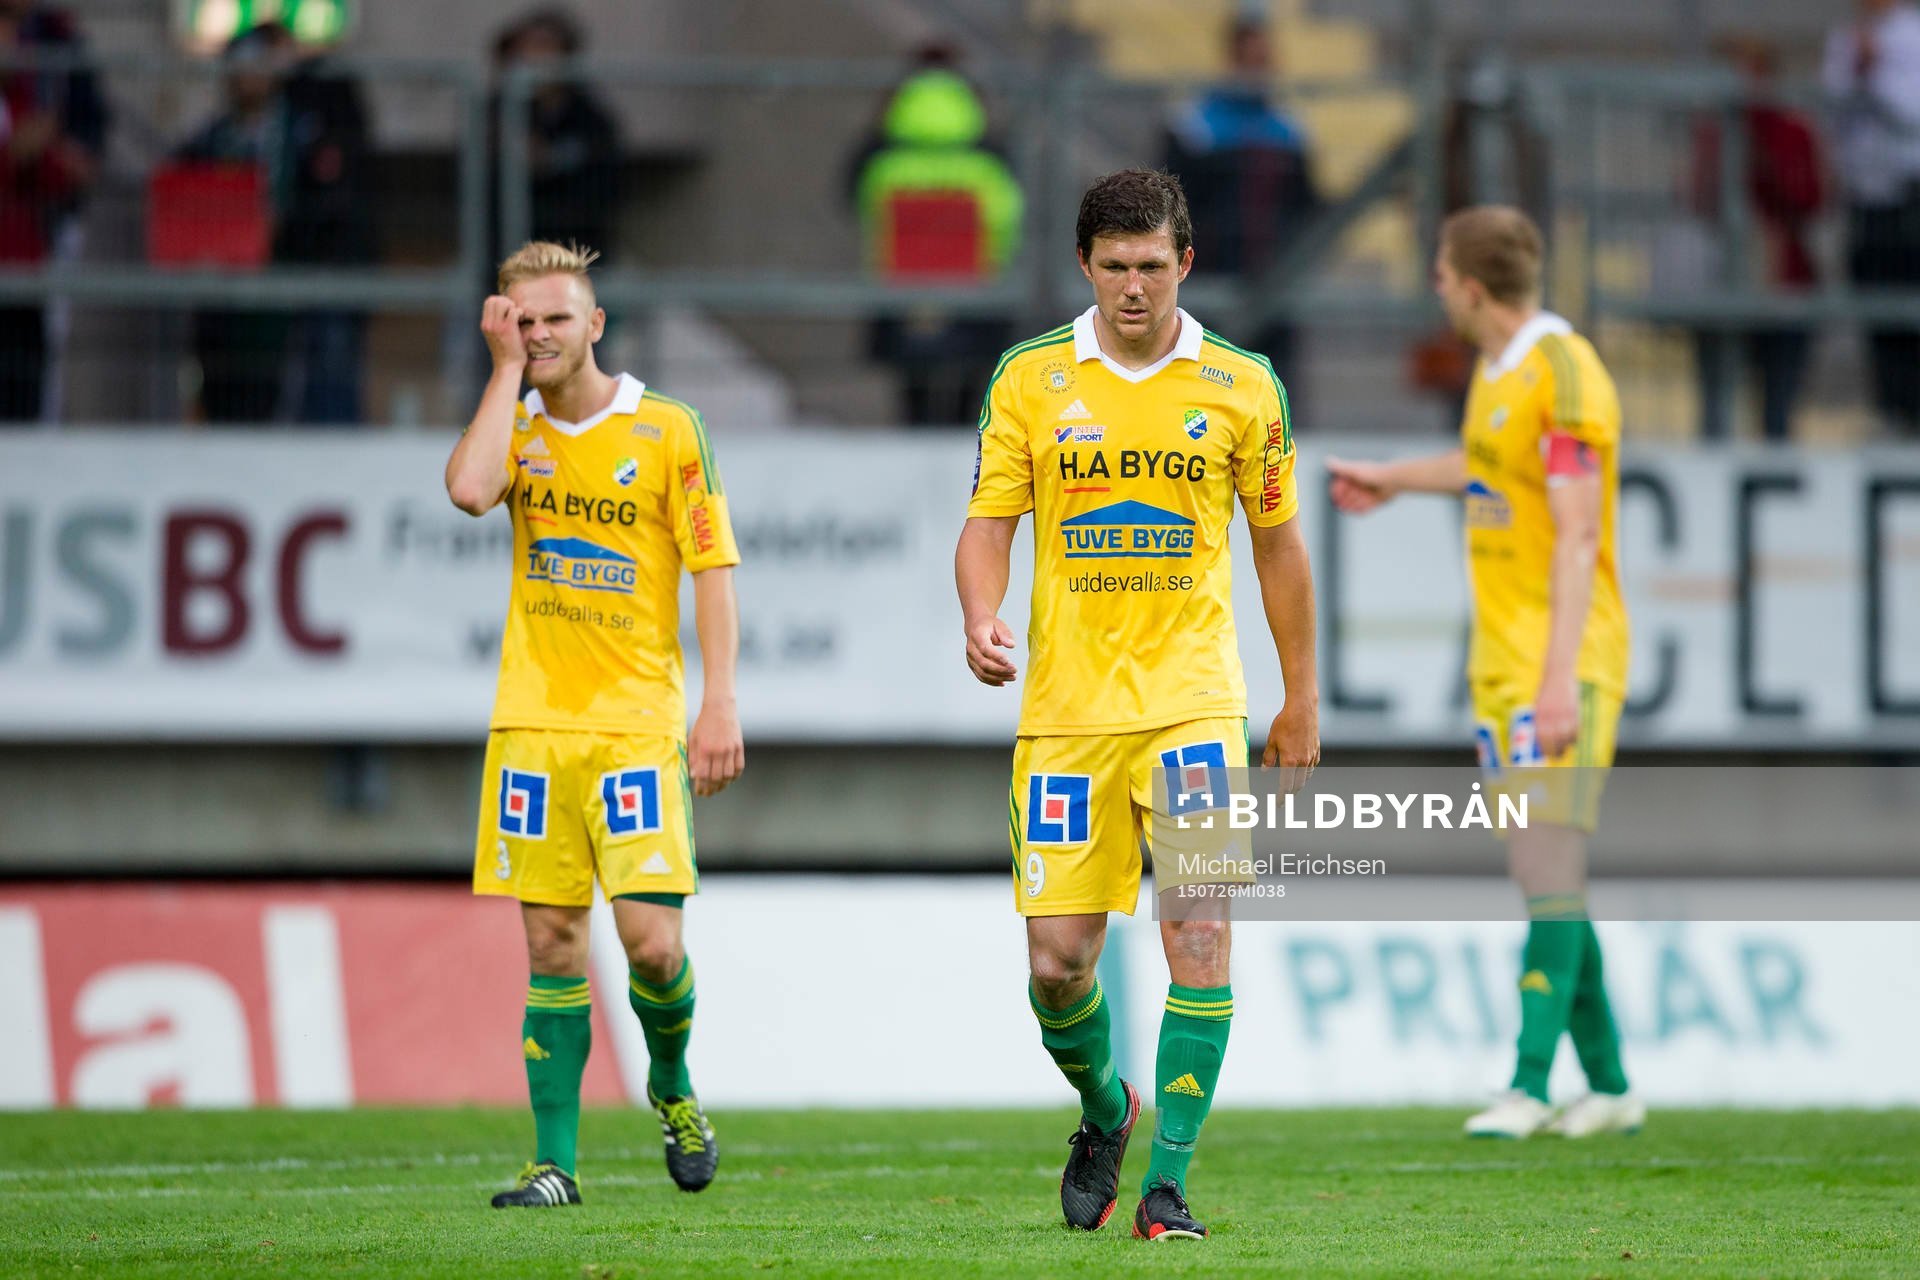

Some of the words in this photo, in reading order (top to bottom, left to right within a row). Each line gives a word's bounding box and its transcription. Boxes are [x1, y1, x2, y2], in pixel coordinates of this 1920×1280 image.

[1201, 365, 1236, 385] MUNK
[1074, 426, 1104, 434] INTER
[1074, 434, 1103, 442] SPORT
[1060, 450, 1110, 480] H.A
[1121, 450, 1207, 482] BYGG
[1264, 417, 1282, 513] TAKORAMA
[565, 492, 637, 527] BYGG
[1061, 529, 1123, 550] TUVE
[1132, 528, 1194, 549] BYGG
[572, 563, 636, 586] BYGG
[1069, 571, 1193, 592] uddevalla.se
[525, 597, 634, 630] uddealla.se
[495, 839, 512, 880] 3
[1026, 851, 1046, 897] 9
[1164, 1083, 1205, 1098] adidas
